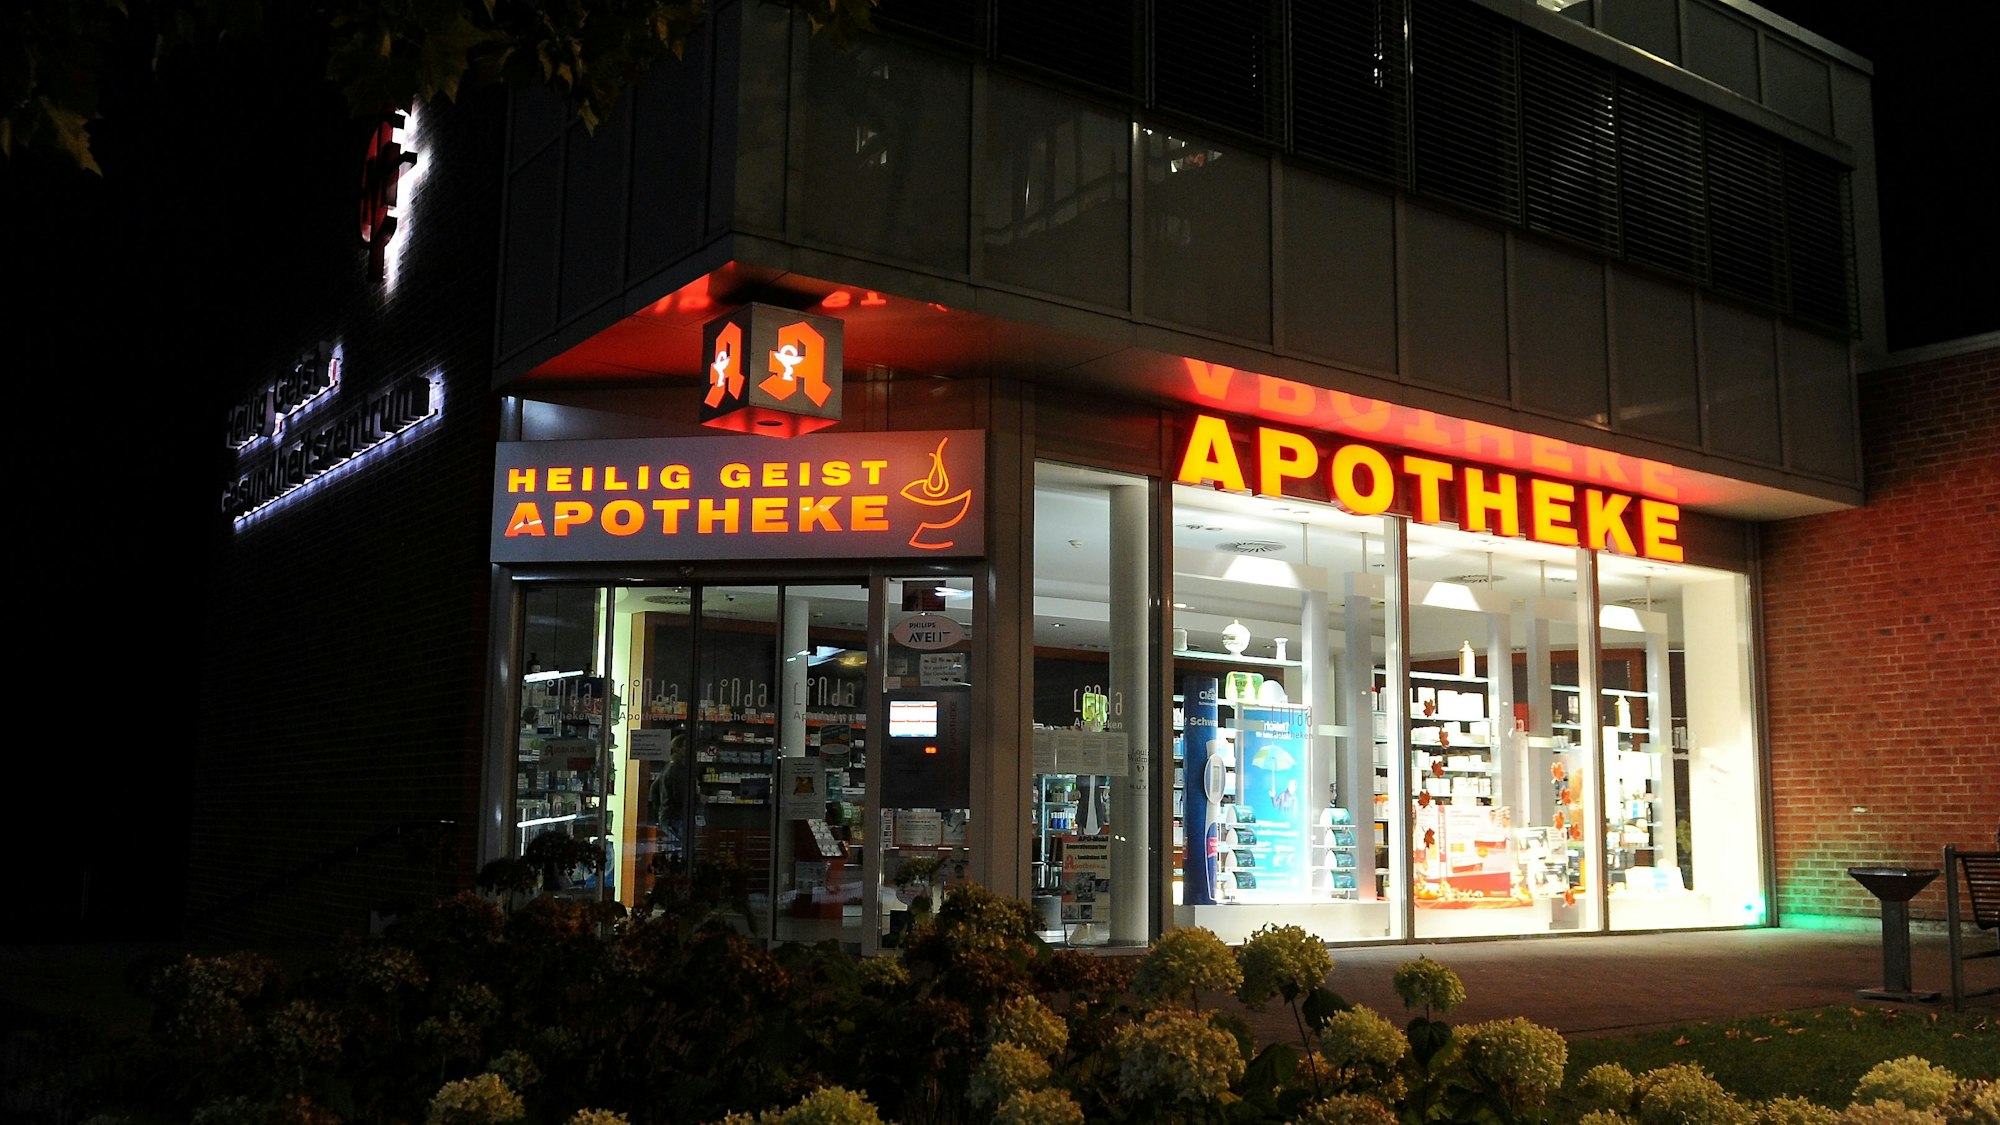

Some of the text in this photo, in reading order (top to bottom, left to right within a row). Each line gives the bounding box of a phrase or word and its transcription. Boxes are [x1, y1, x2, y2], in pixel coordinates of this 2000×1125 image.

[507, 460, 888, 493] HEILIG GEIST
[1177, 413, 1684, 562] APOTHEKE
[504, 494, 889, 537] APOTHEKE
[1073, 717, 1123, 729] Apheken
